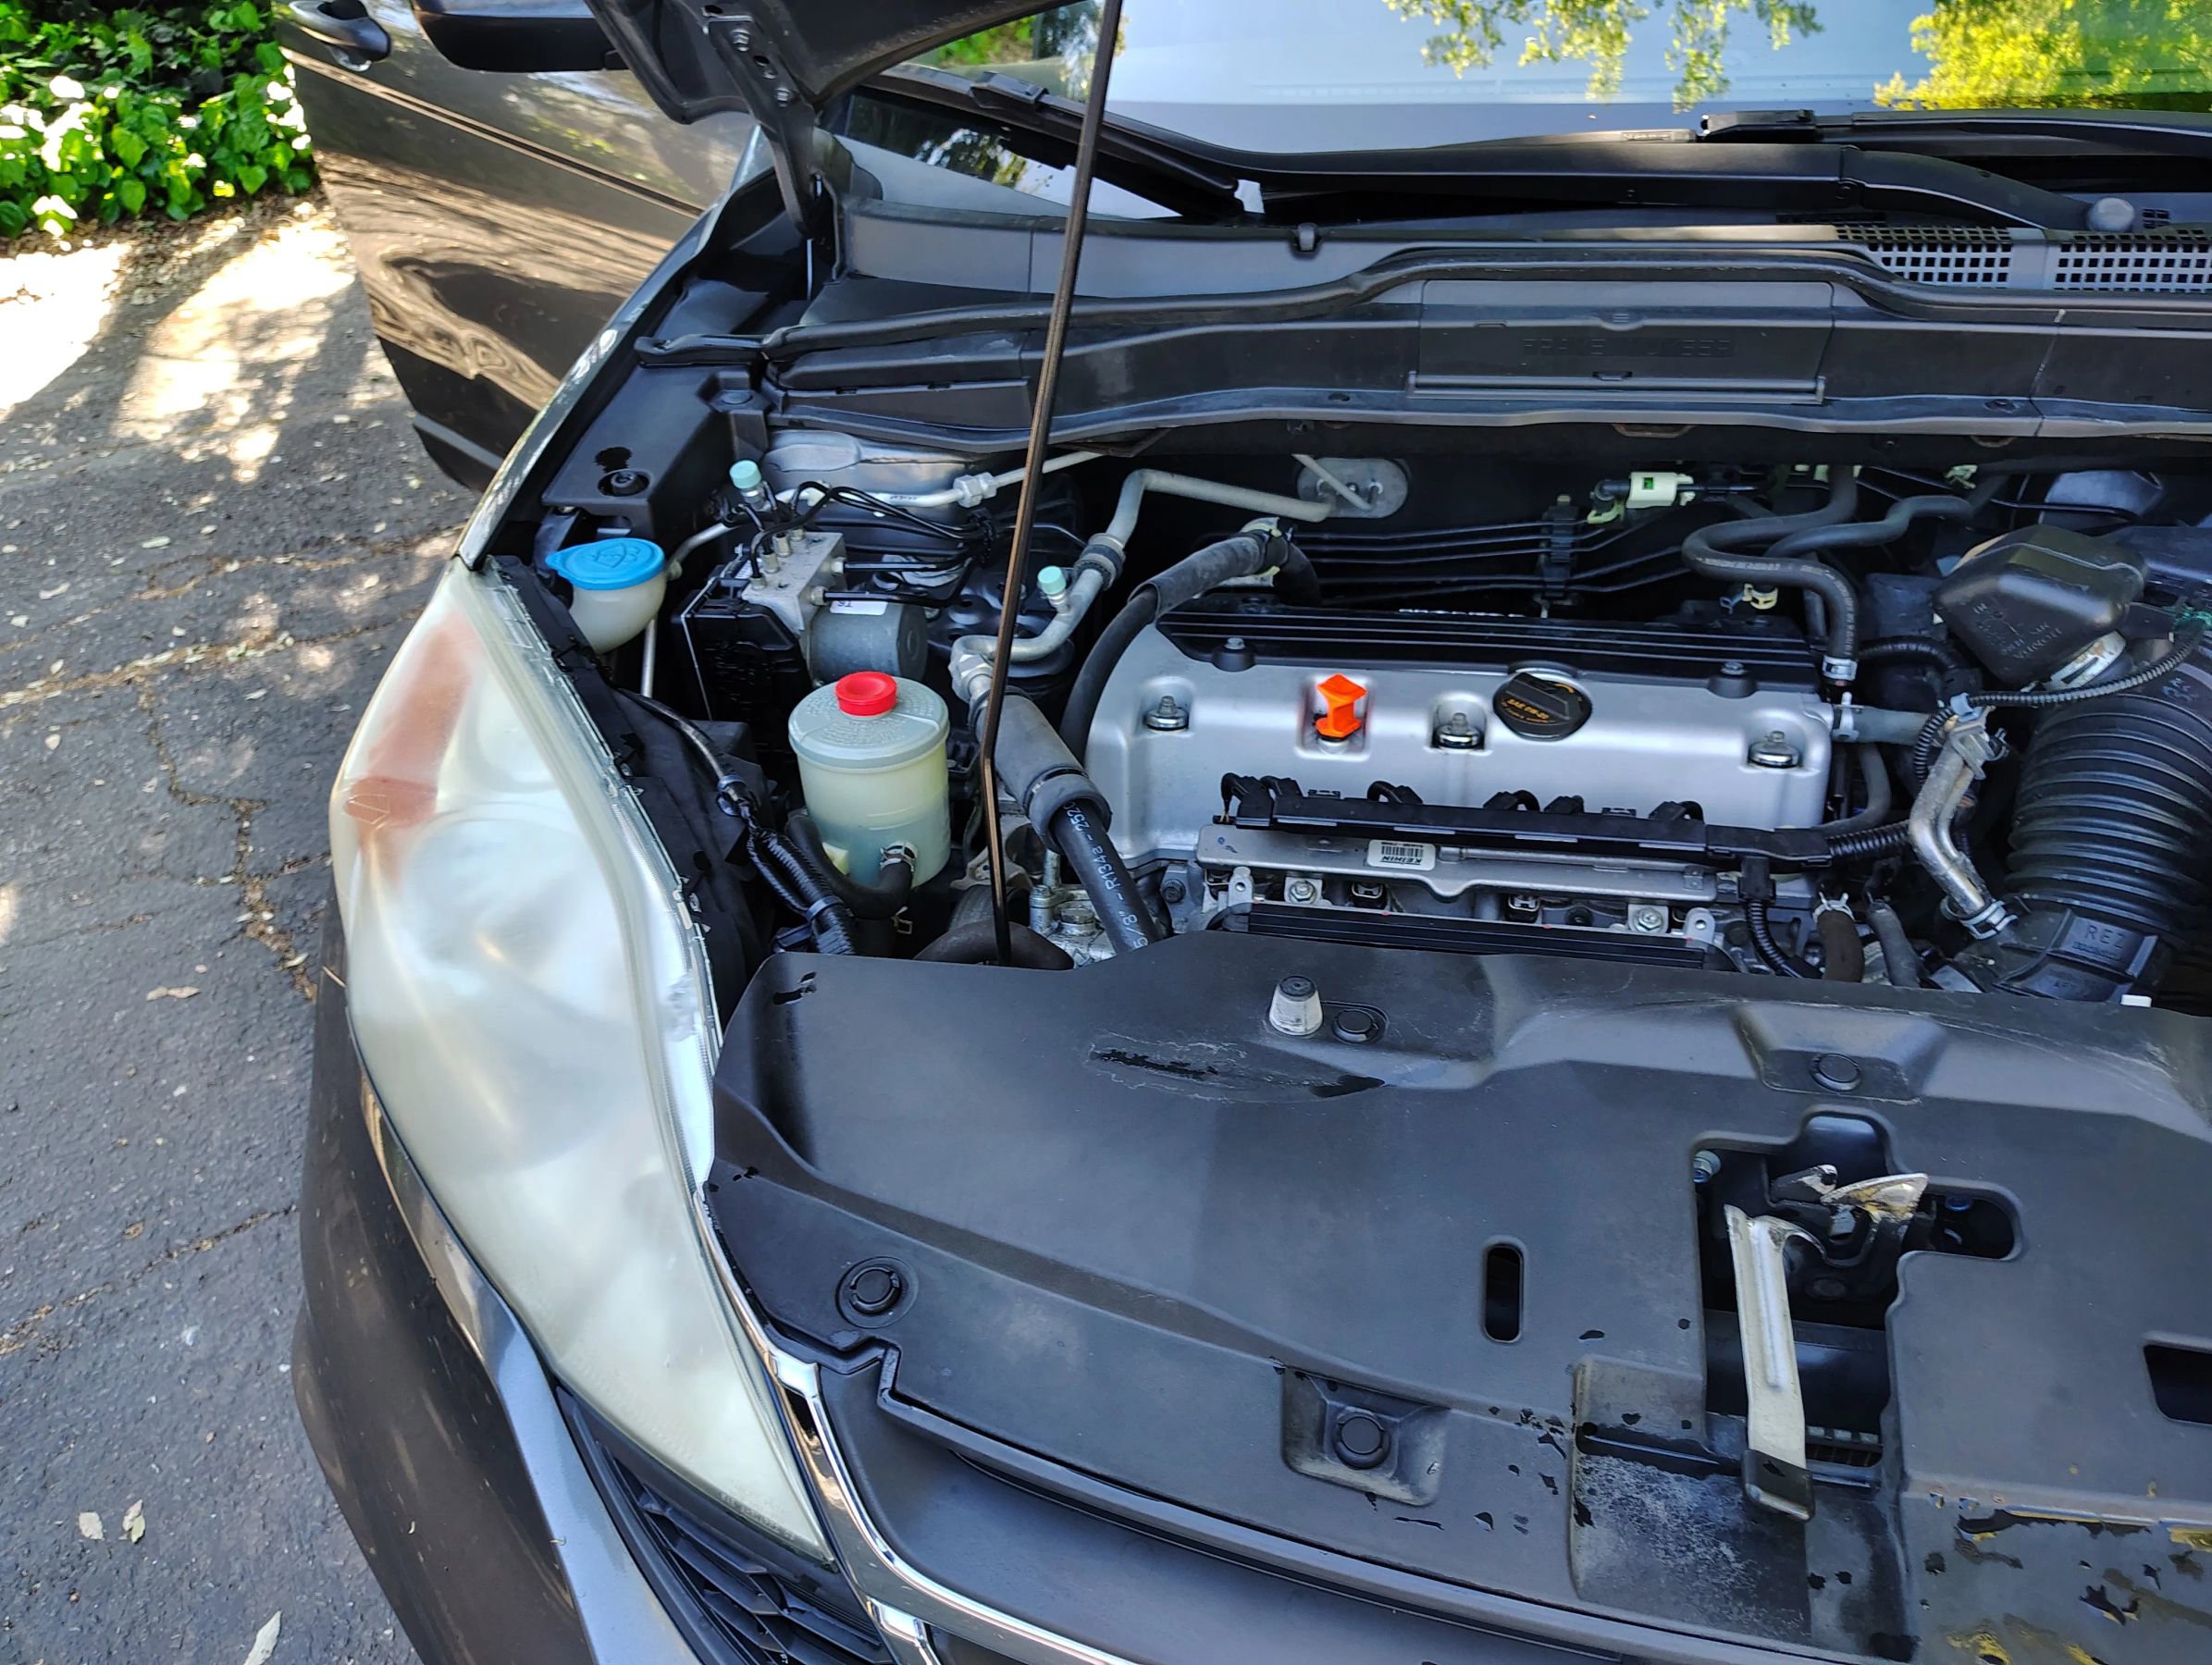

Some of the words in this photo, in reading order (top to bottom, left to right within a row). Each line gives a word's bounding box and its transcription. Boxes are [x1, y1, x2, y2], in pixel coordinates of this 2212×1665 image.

[1524, 339, 1607, 355] FRAE
[1092, 845, 1121, 890] R134a
[1380, 856, 1423, 865] KEIHIN
